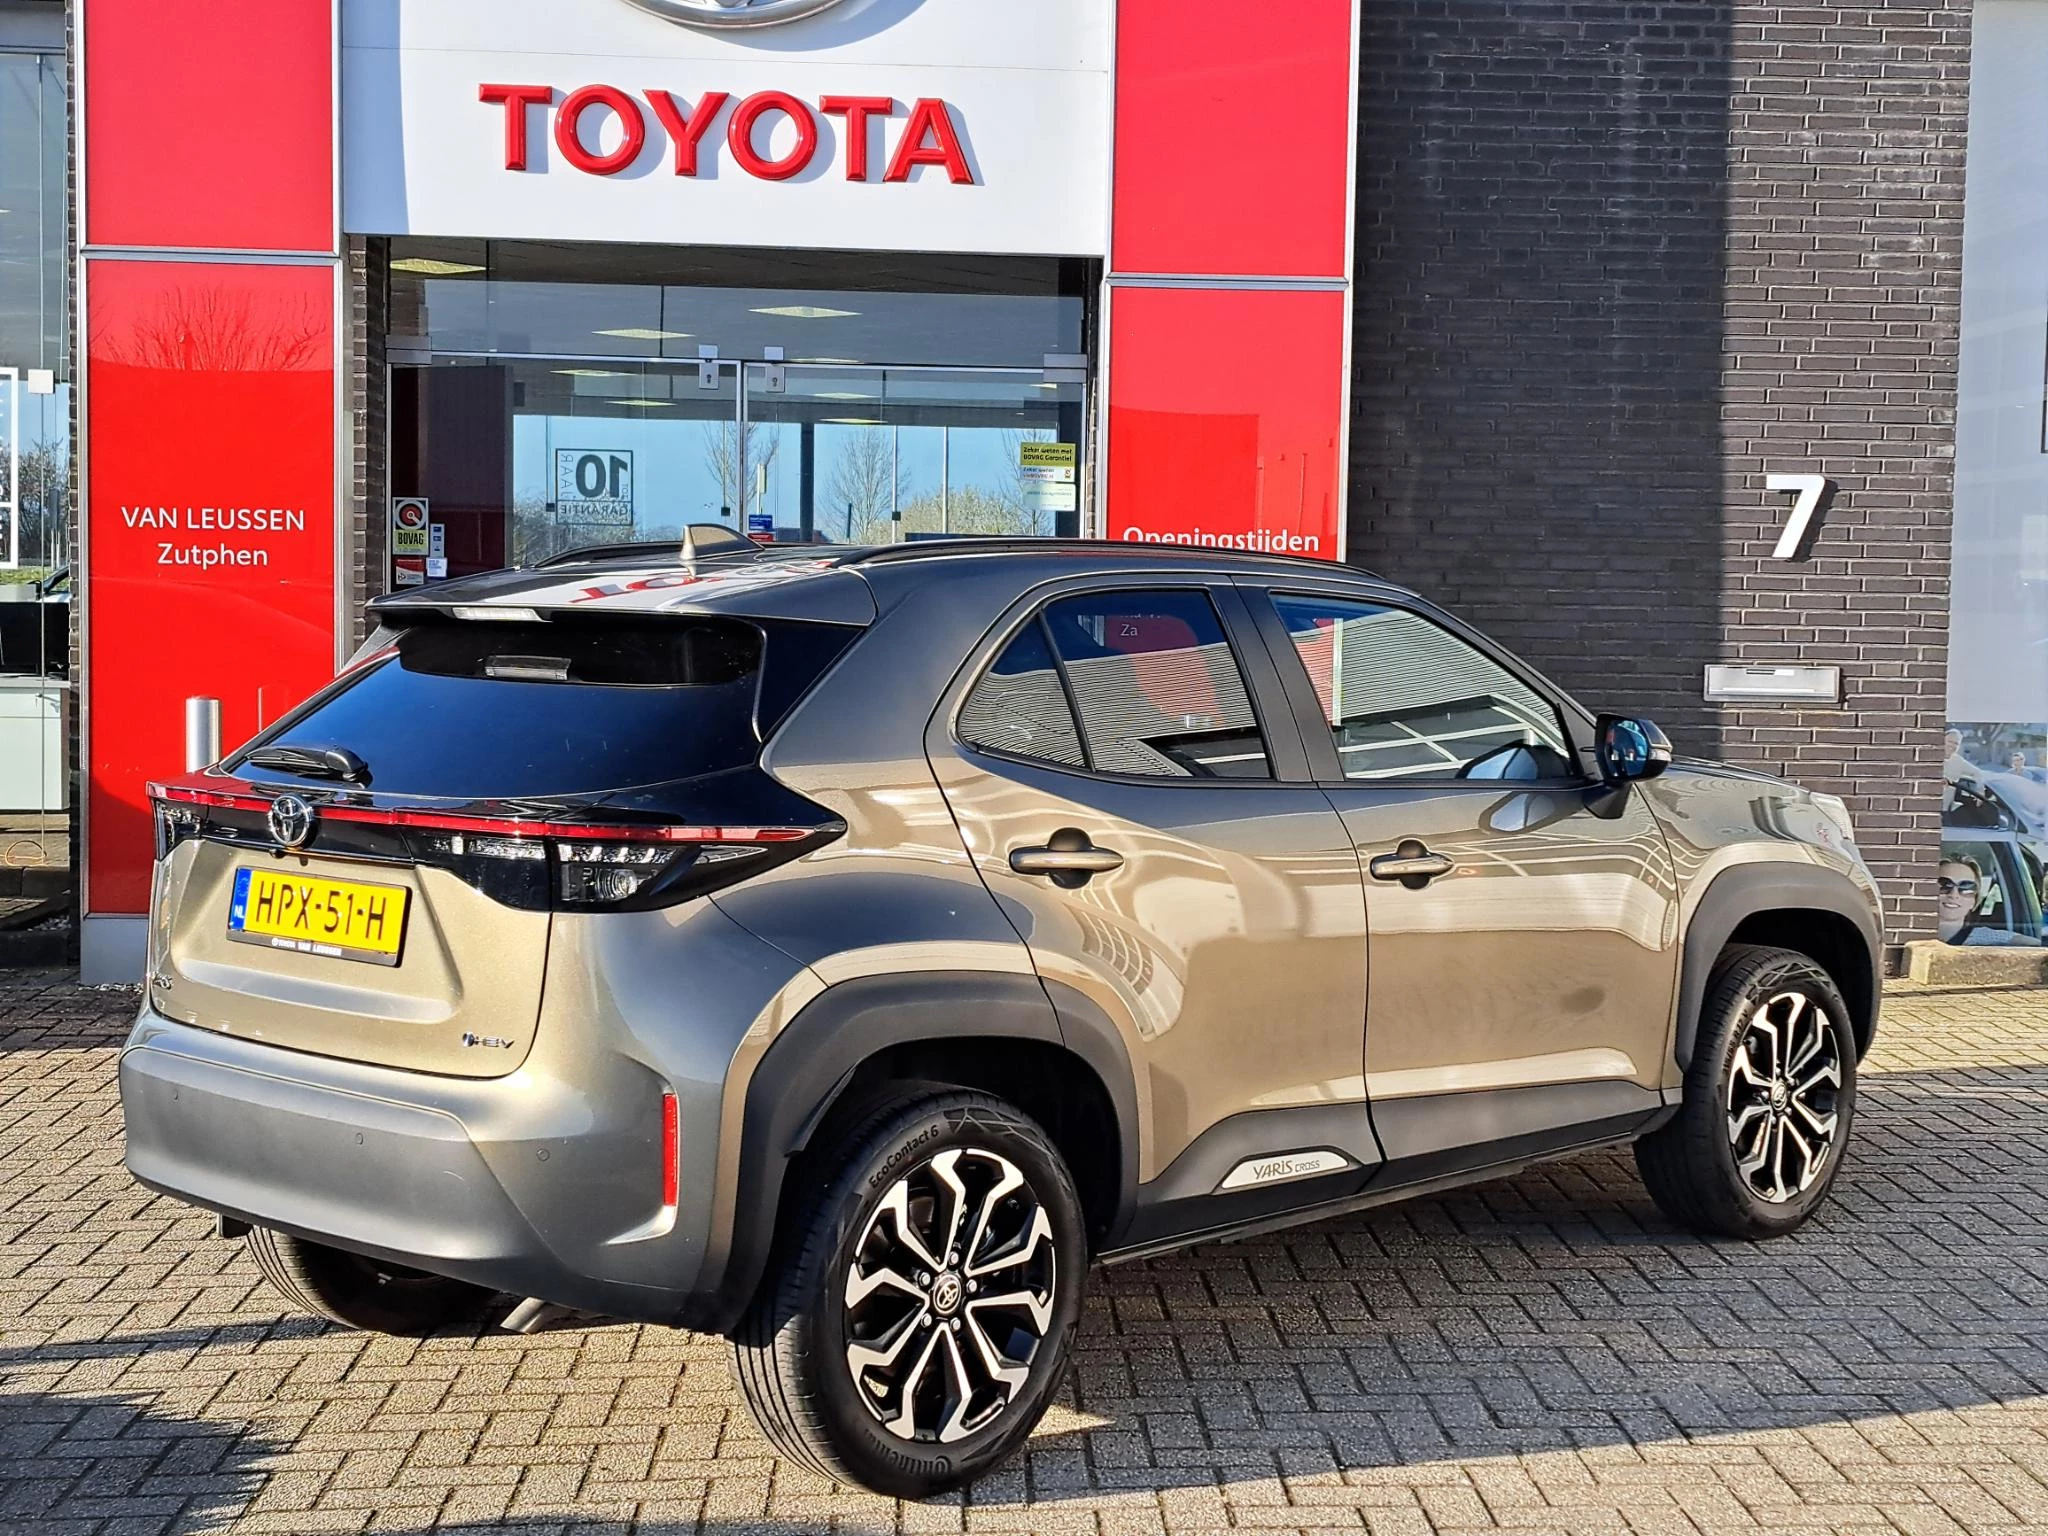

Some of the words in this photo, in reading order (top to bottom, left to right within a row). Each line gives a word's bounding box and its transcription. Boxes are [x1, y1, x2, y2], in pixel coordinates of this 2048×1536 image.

[479, 83, 974, 185] TOYOTA
[121, 507, 178, 529] VAN
[187, 508, 304, 531] LEUSSEN
[1766, 474, 1825, 558] 7
[397, 532, 424, 545] BOVAG
[157, 543, 268, 570] Zutphen
[1121, 623, 1138, 636] Za
[233, 904, 246, 918] NL
[256, 881, 386, 940] HPX-51-H
[868, 1130, 930, 1188] EcoContact
[930, 1124, 940, 1139] 6
[1294, 1160, 1320, 1173] CROSS
